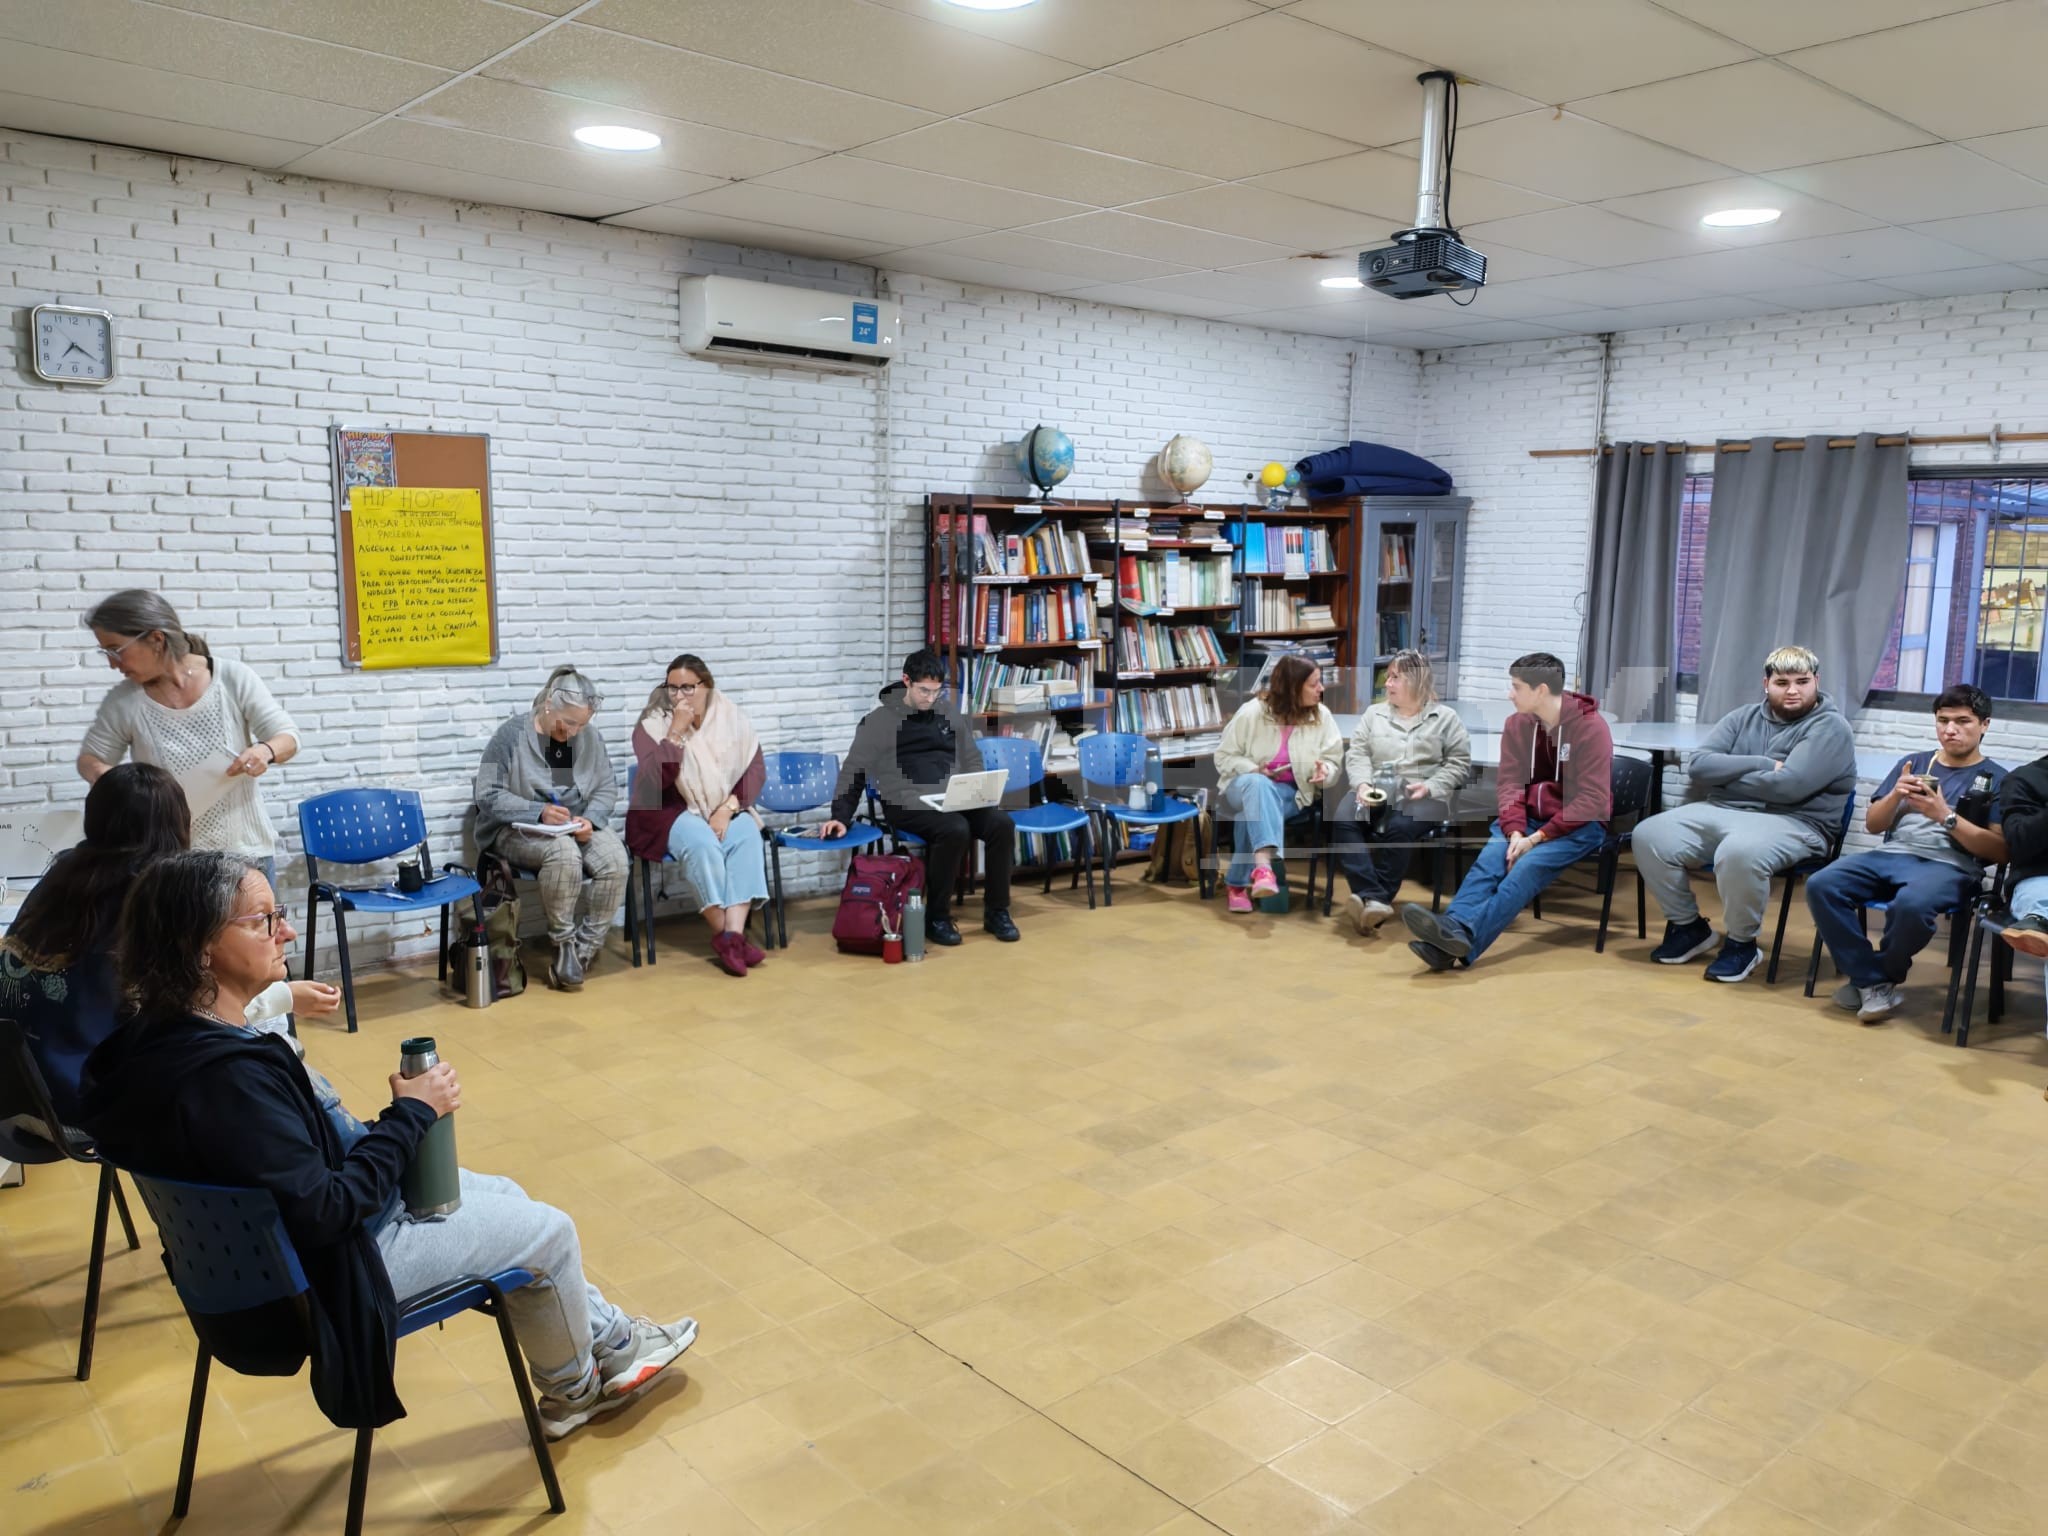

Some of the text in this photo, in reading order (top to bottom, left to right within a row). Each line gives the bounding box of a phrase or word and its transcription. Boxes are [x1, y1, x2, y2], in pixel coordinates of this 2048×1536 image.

[68, 316, 79, 325] 12
[43, 324, 53, 333] 10
[363, 488, 444, 509] HIP HOP
[357, 515, 401, 528] AMASAR
[404, 519, 415, 528] LA
[401, 544, 412, 552] LA
[361, 601, 375, 610] EL
[382, 599, 399, 609] FPB
[367, 614, 407, 625] ACTIVANDO
[411, 612, 423, 620] EN
[426, 623, 437, 632] LA
